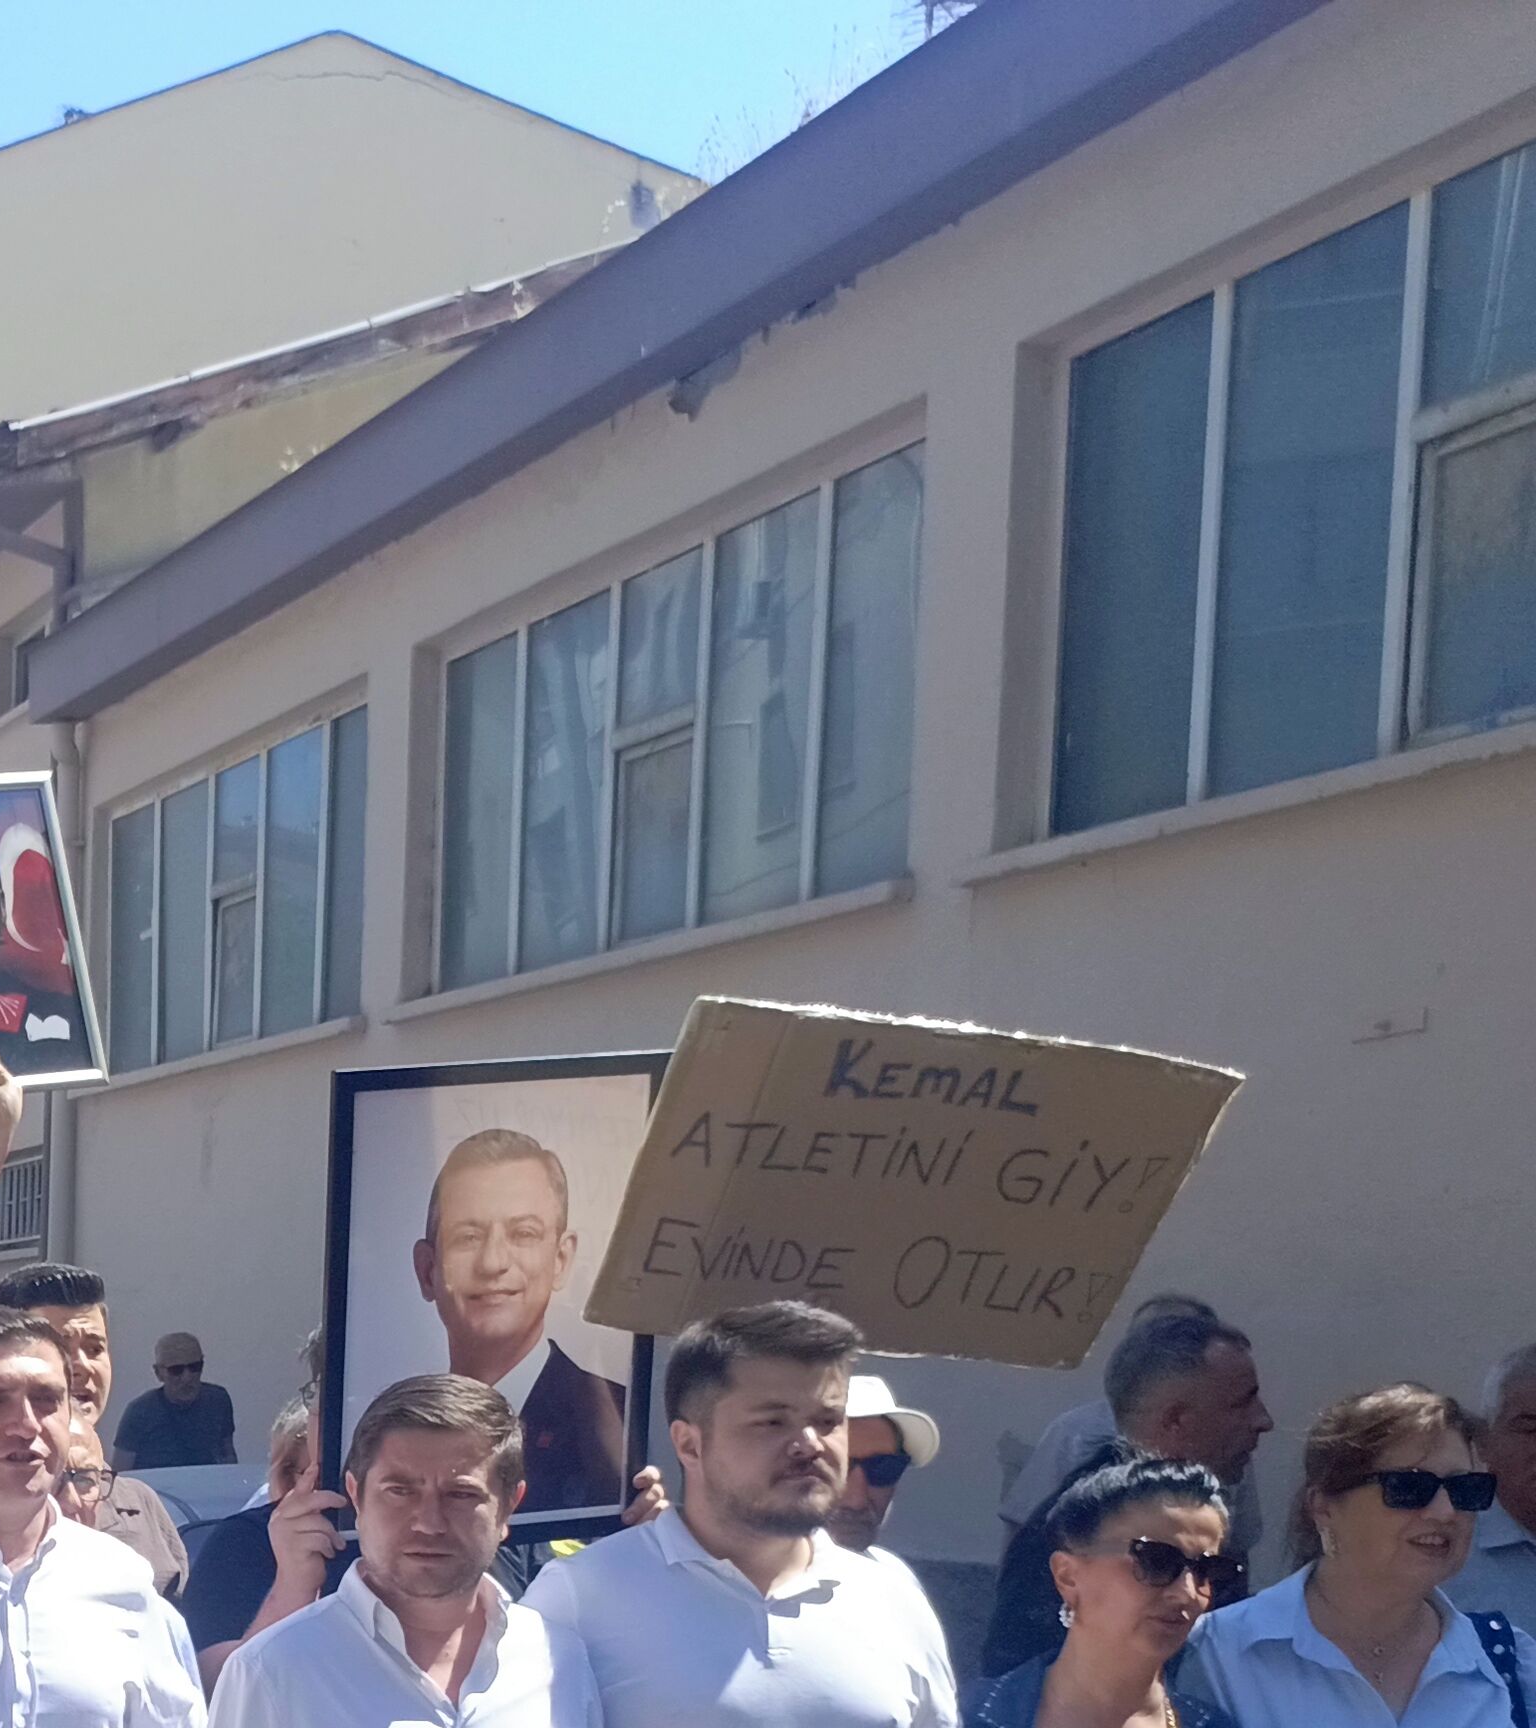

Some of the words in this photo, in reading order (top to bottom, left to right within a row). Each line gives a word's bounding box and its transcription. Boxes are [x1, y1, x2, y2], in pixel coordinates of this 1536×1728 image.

[821, 1037, 1040, 1117] KEMAL
[670, 1111, 976, 1187] ATLETİNİ
[642, 1216, 857, 1291] EVİNDE
[892, 1235, 1116, 1323] OTUR!
